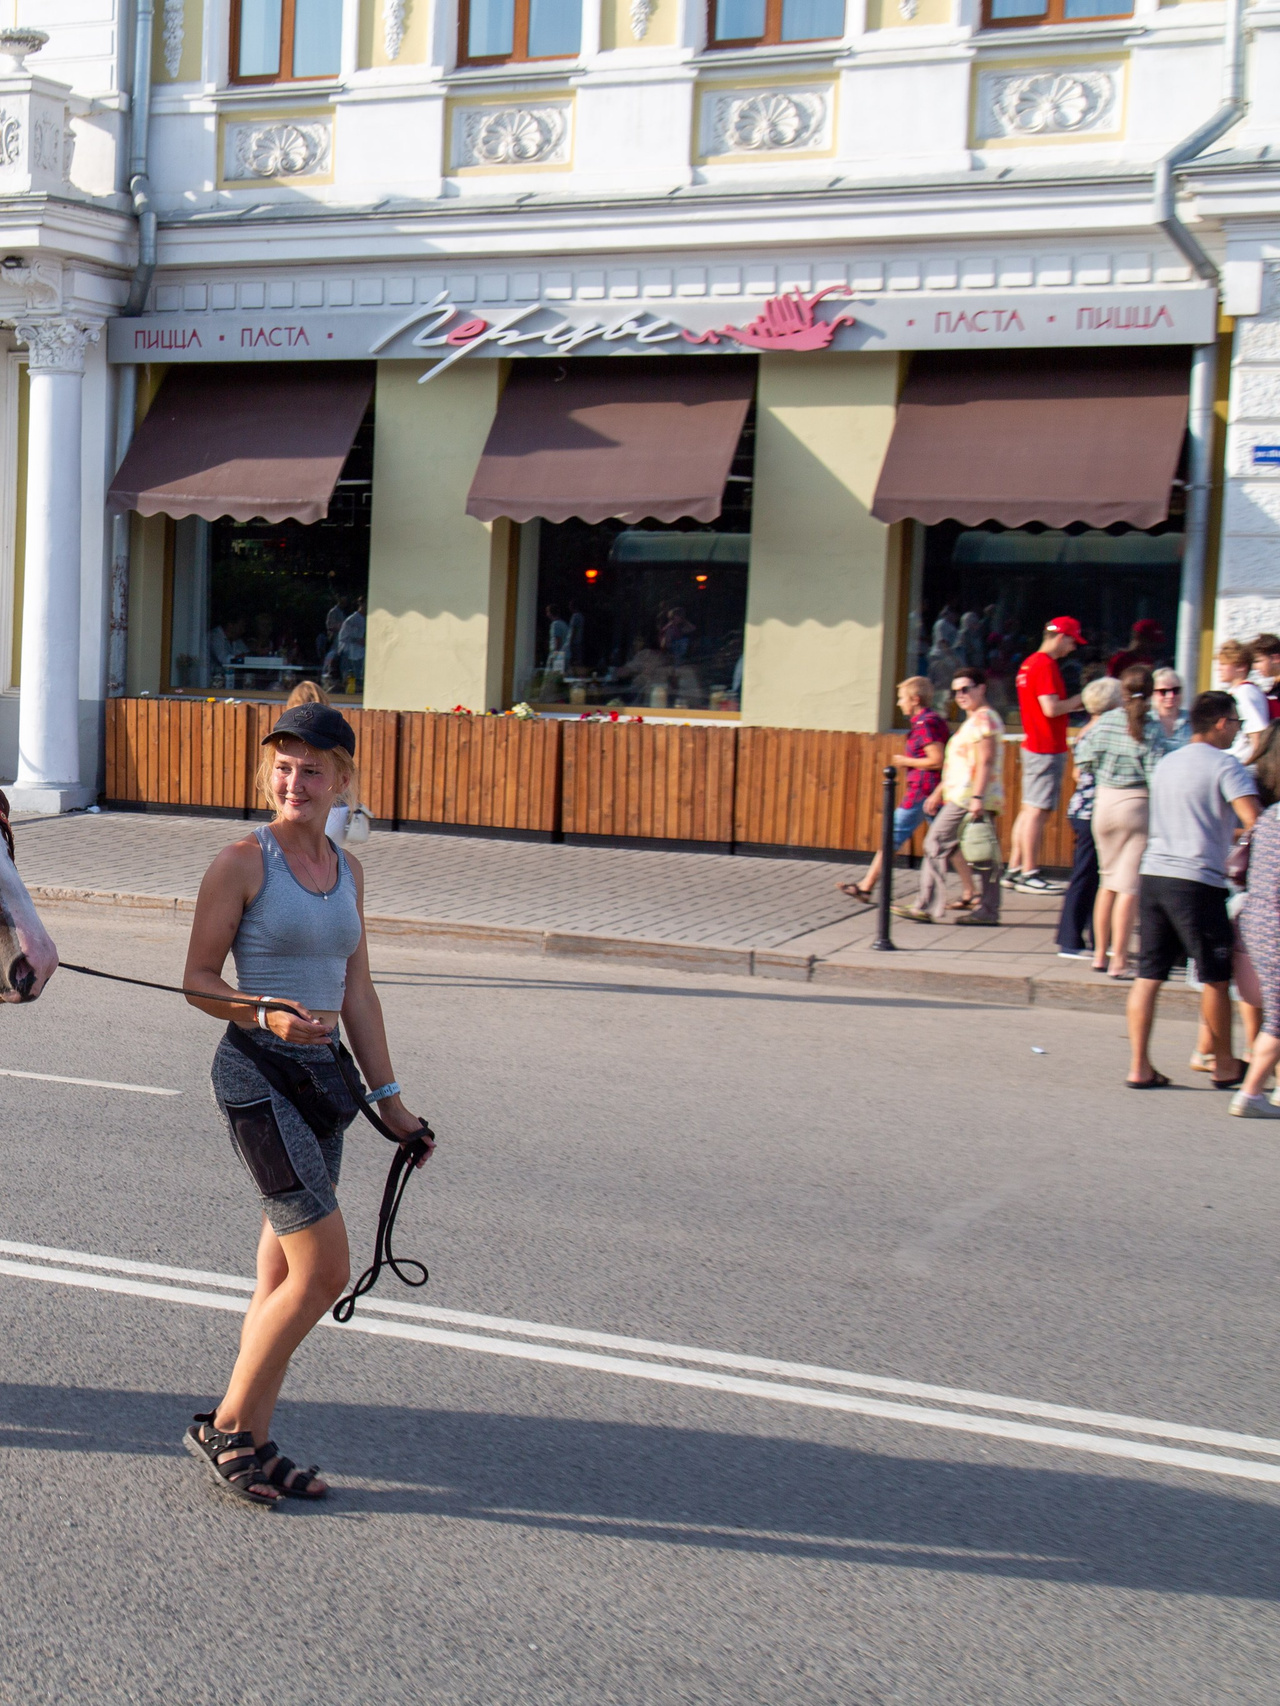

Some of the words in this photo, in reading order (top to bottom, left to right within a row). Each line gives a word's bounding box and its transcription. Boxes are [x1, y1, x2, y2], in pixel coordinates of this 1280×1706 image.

[134, 328, 202, 350] ПИЦЦА
[241, 326, 309, 348] ПАСТА
[934, 309, 1026, 333] ПАСТА
[1076, 304, 1175, 330] ПИЦЦА
